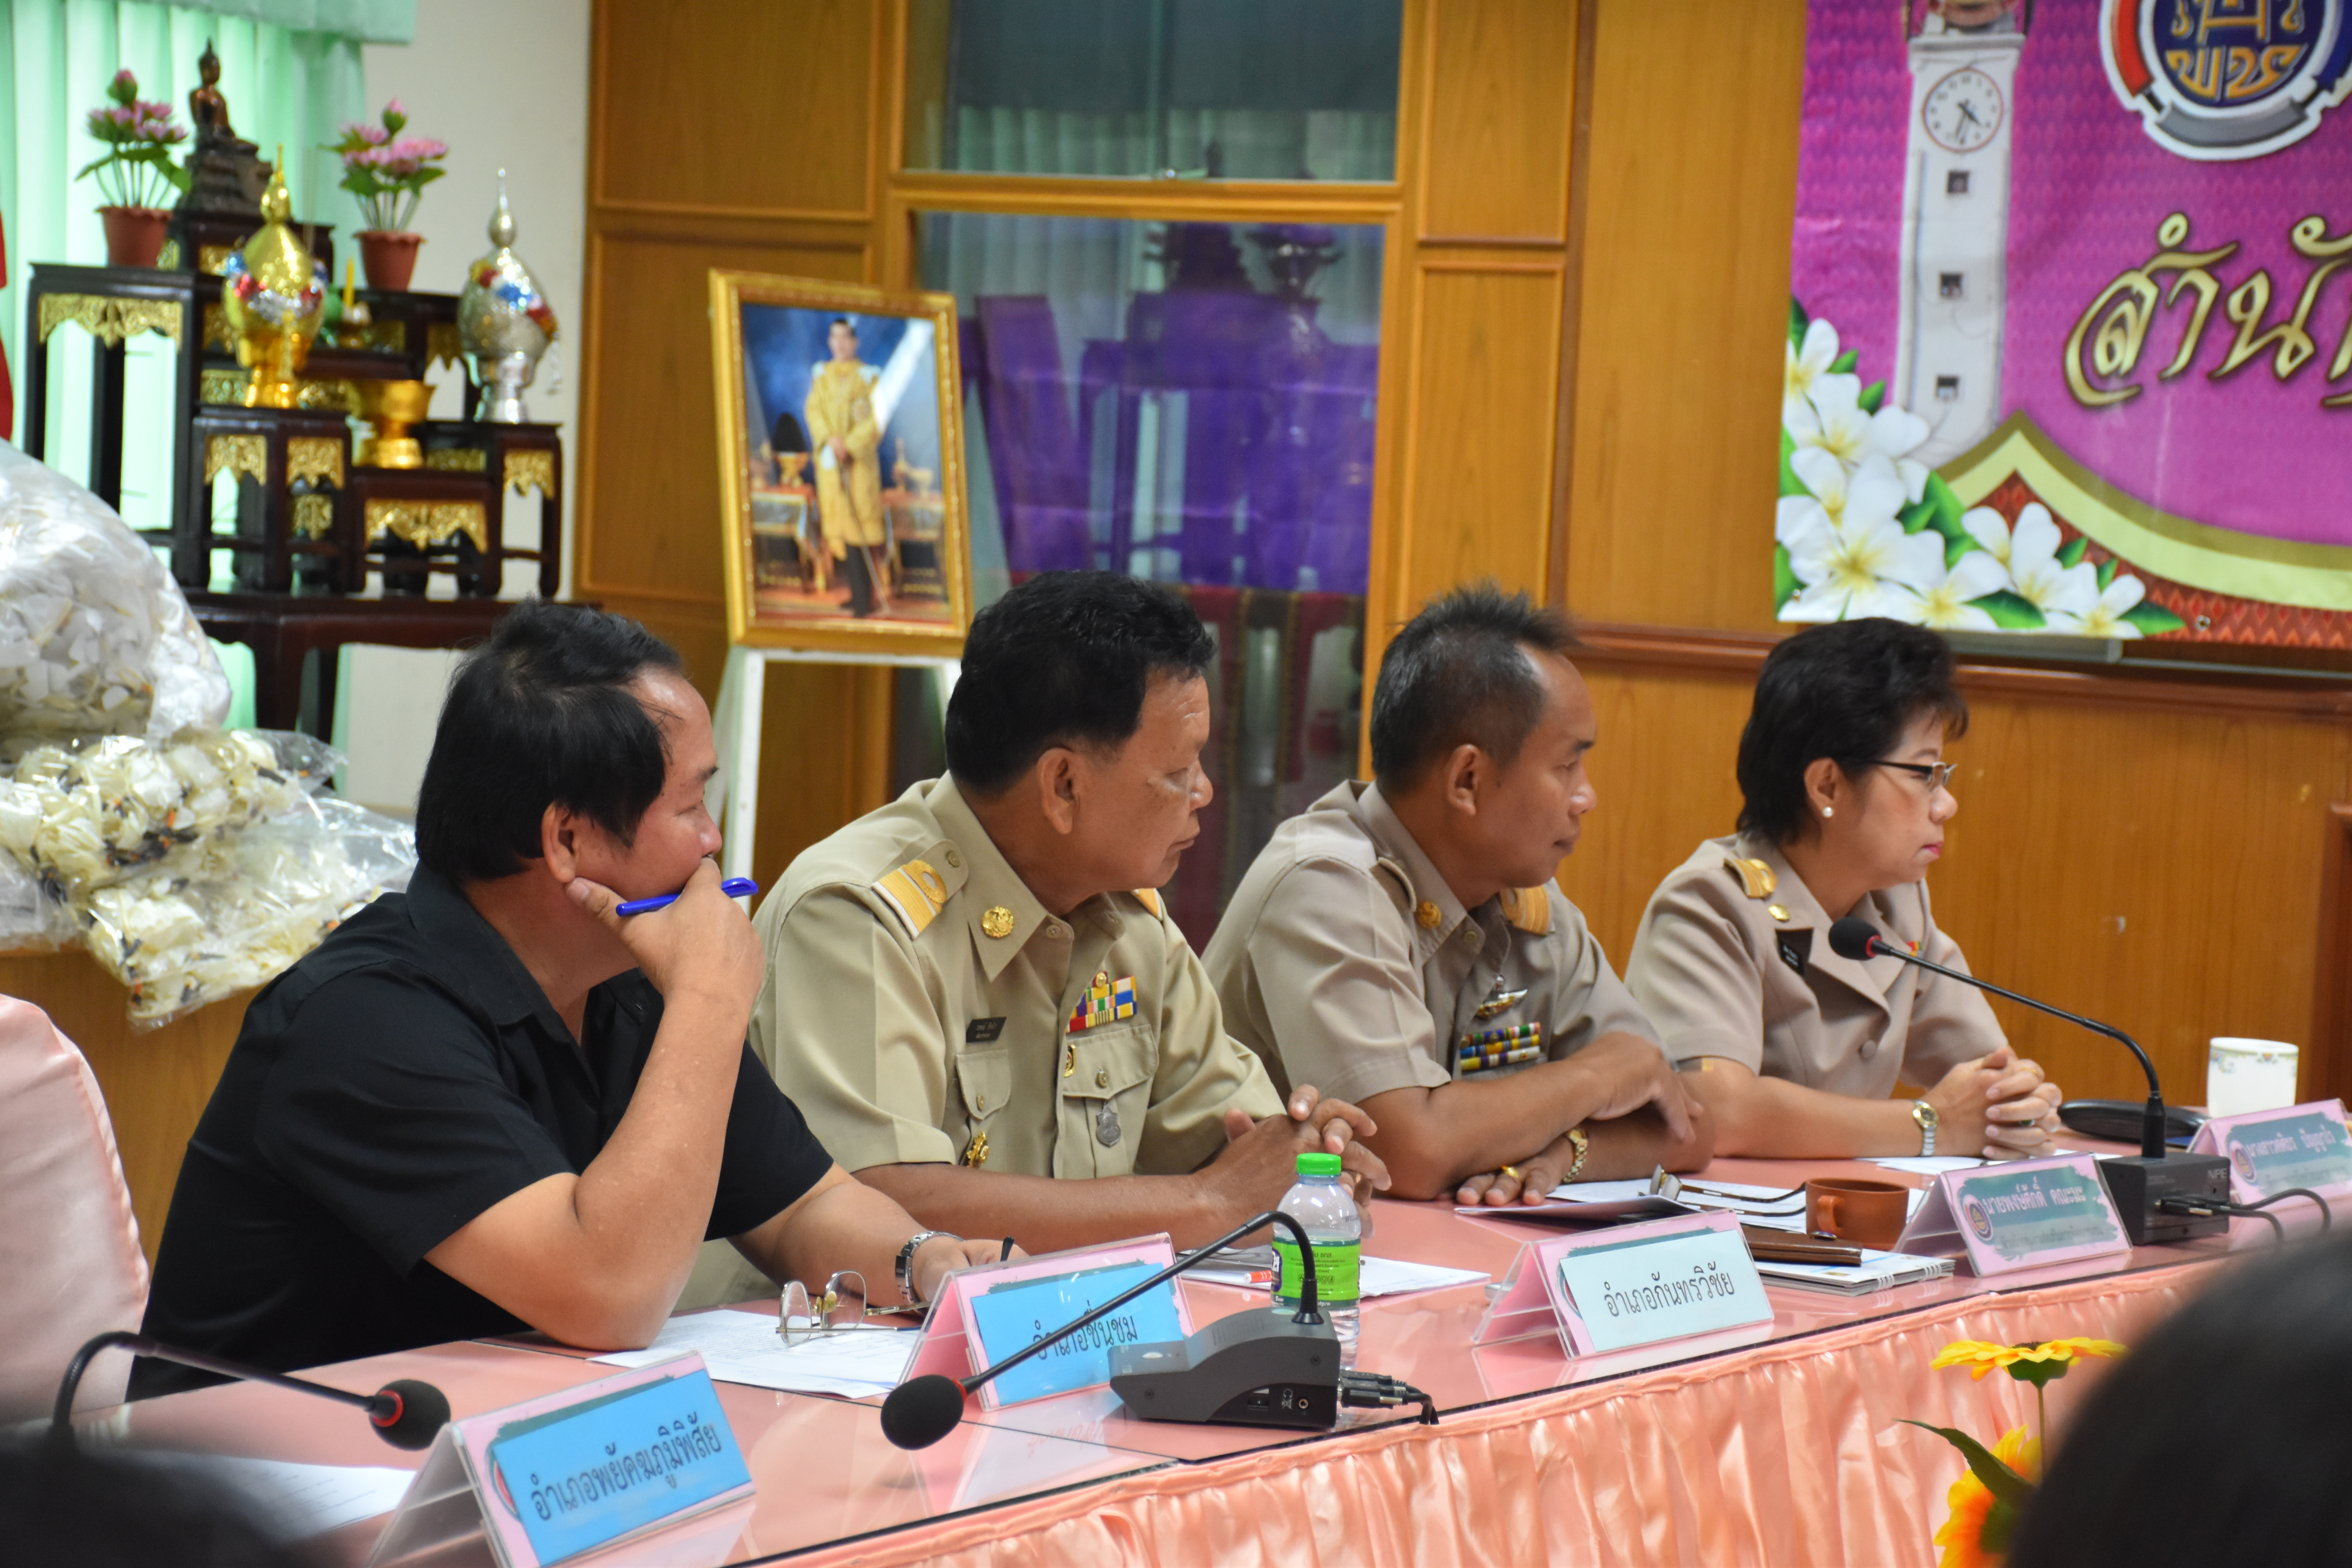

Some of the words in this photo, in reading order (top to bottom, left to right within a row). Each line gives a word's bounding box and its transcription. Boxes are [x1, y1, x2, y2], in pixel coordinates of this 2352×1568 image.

[2063, 212, 2352, 406] สำนั
[1604, 1261, 1735, 1317] อำเภอกันทรวิชัย
[530, 1411, 722, 1521] อำเภอพยัคฆภูมิพิสัย
